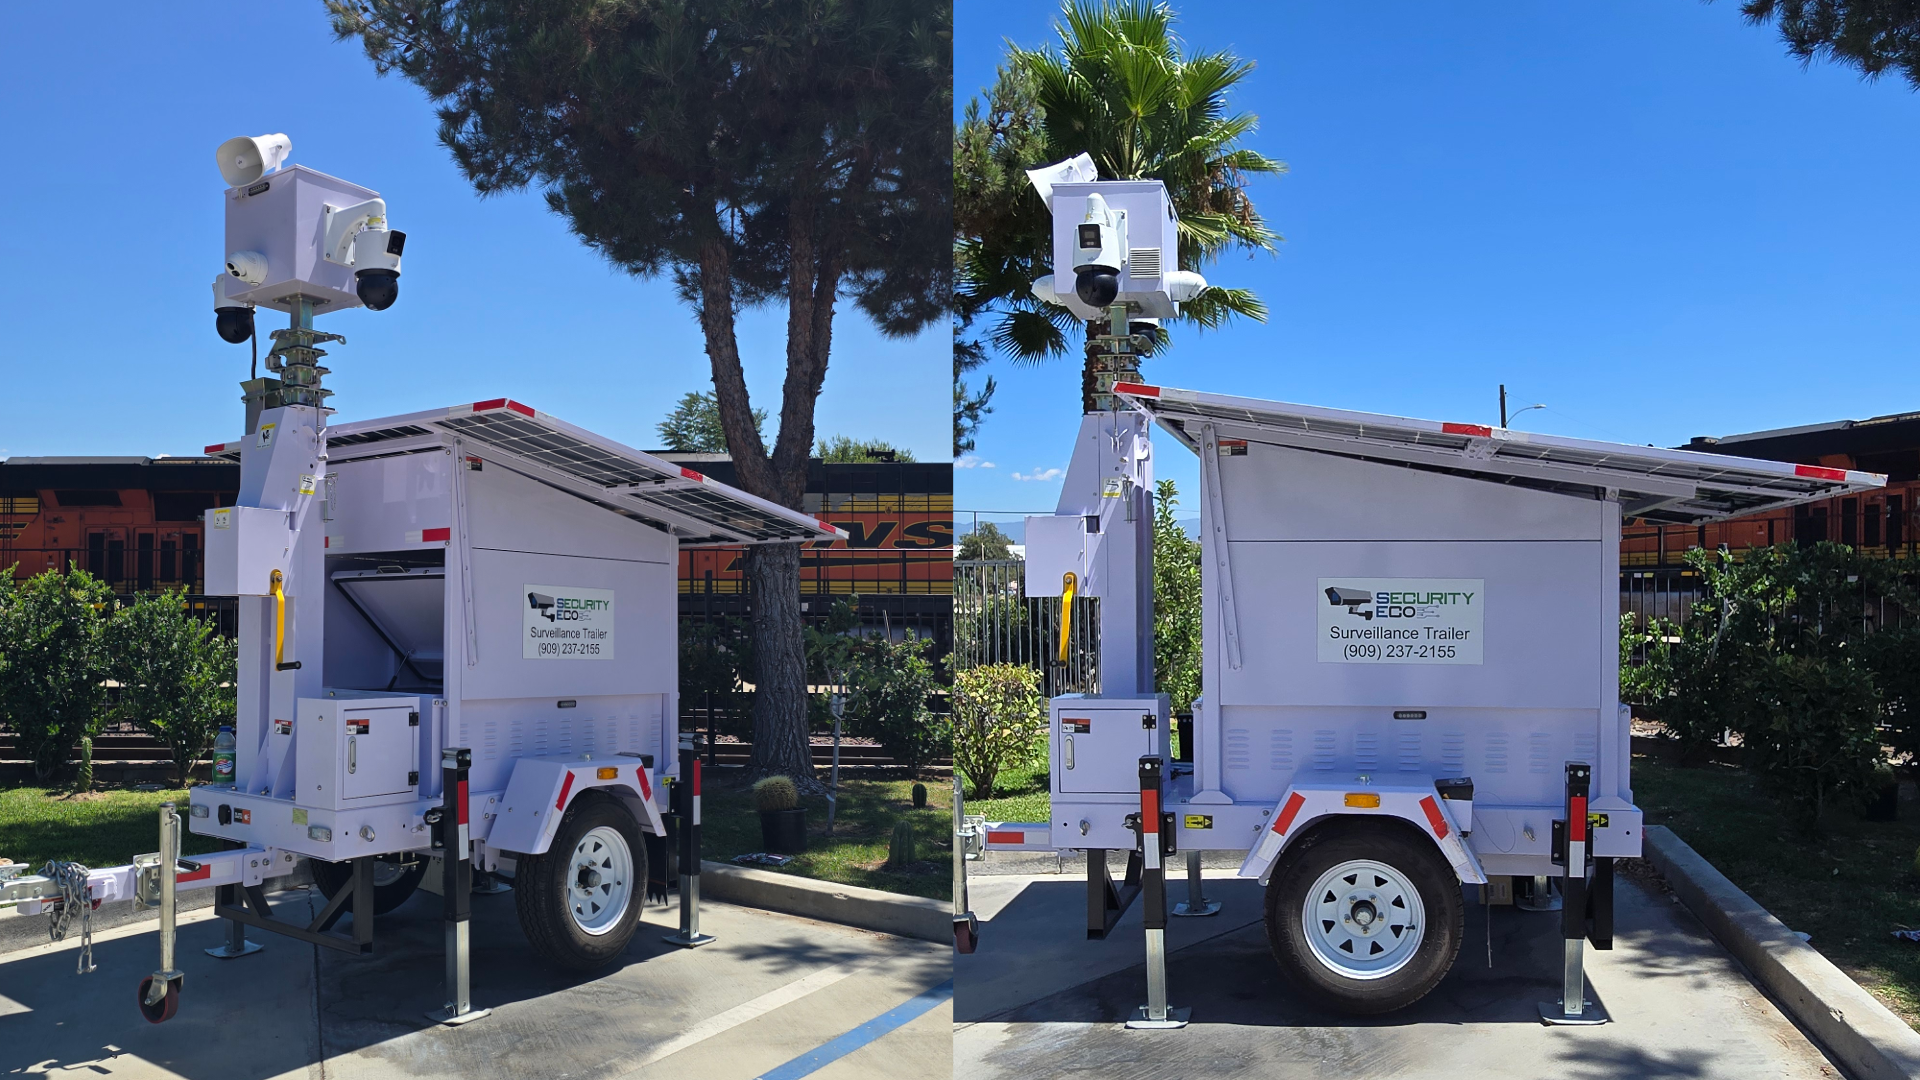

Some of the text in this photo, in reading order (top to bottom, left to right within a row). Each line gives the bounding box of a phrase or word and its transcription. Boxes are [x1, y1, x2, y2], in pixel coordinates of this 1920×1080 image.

[556, 598, 610, 610] SECURITY
[1376, 592, 1475, 605] SECURITY
[556, 610, 579, 621] ECO
[1376, 606, 1416, 618] ECO
[530, 626, 608, 640] Surveillance Trailer
[1330, 626, 1470, 640] Surveillance Trailer
[538, 642, 600, 657] (909) 237-2155
[1343, 644, 1456, 660] (909) 237-2155
